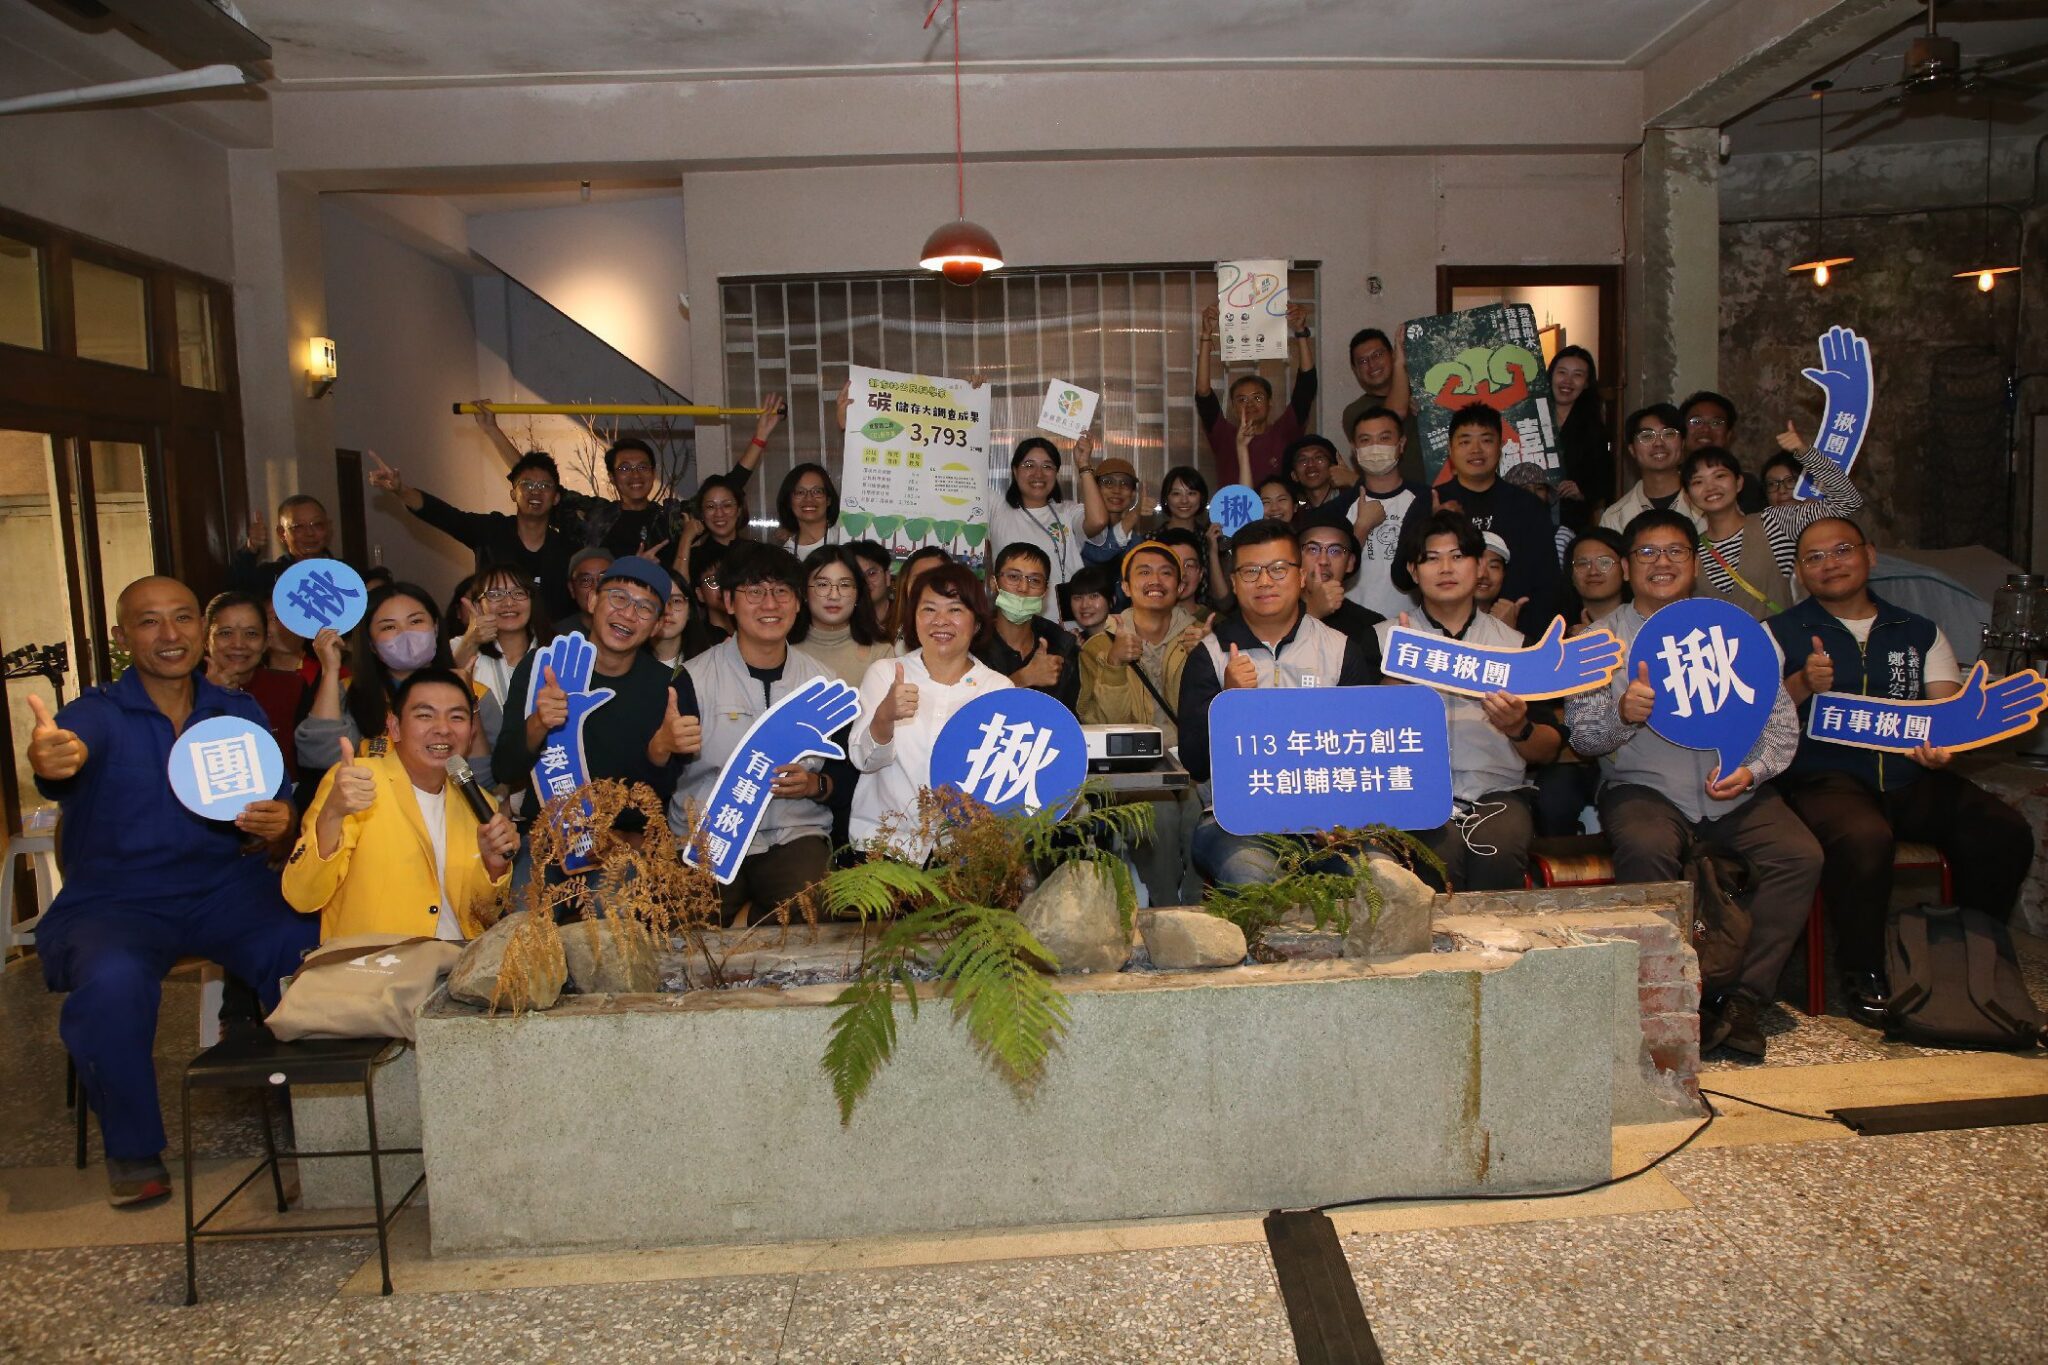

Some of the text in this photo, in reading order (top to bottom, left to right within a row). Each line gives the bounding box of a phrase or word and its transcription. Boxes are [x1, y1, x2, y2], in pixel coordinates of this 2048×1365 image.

[910, 423, 968, 448] 3,793
[1220, 495, 1253, 528] 揪
[286, 570, 361, 628] 揪
[1397, 642, 1512, 688] 有事揪團
[1656, 625, 1756, 718] 揪
[1888, 650, 1906, 700] 鄭光宏
[1235, 726, 1425, 757] 113 年地方創生
[1822, 705, 1933, 742] 有事揪團
[189, 732, 267, 805] 團
[955, 712, 1061, 817] 揪
[1248, 765, 1414, 796] 共創輔導計畫
[707, 749, 775, 867] 有事揪團
